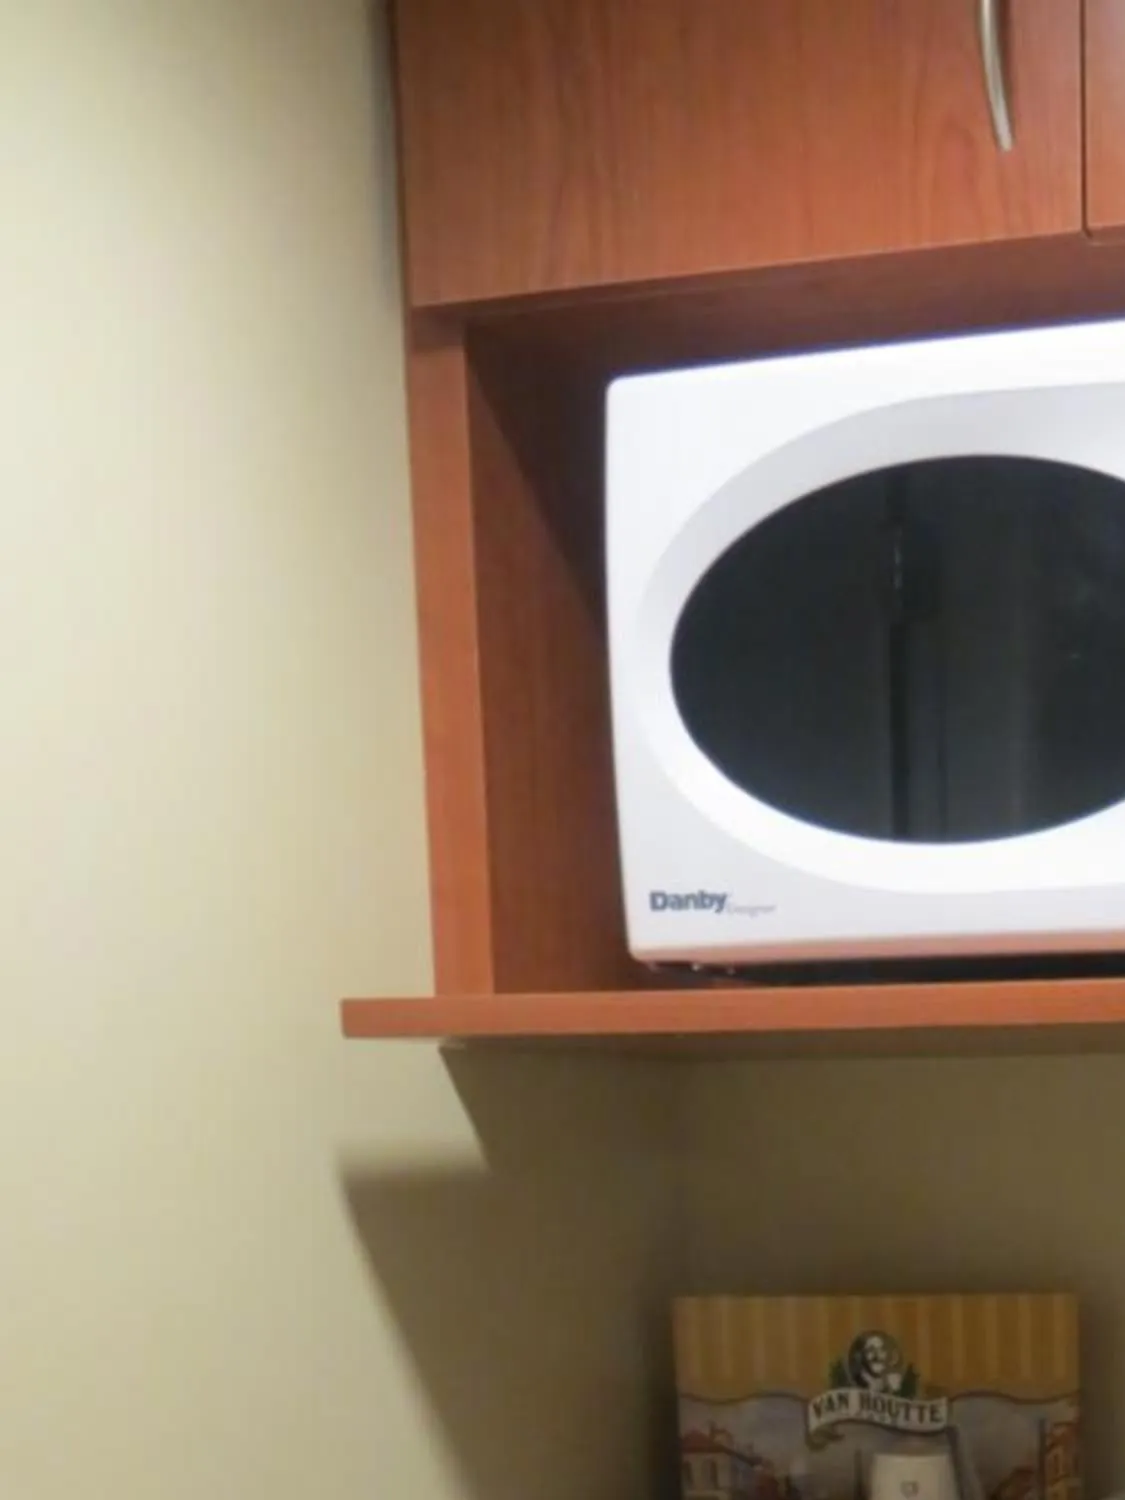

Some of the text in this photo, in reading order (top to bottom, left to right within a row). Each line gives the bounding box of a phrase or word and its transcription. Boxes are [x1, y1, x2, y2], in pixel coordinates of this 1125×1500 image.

[649, 889, 728, 914] Danby
[812, 1391, 944, 1424] VAN HOUTTE
